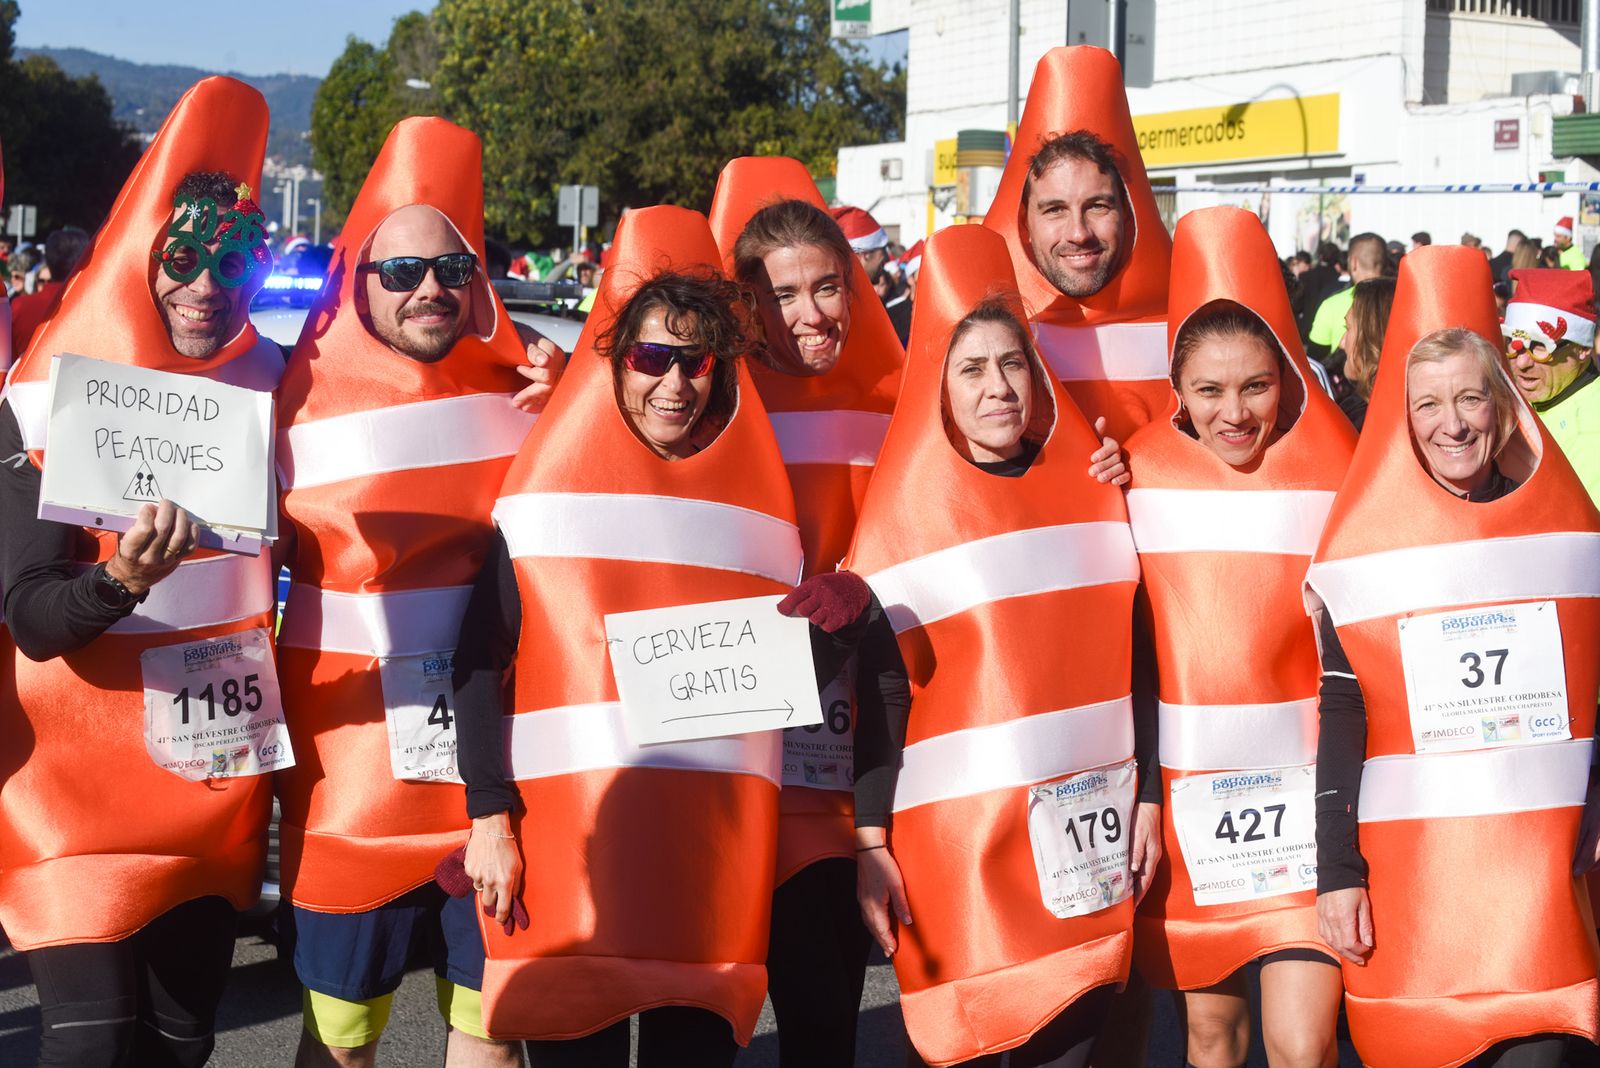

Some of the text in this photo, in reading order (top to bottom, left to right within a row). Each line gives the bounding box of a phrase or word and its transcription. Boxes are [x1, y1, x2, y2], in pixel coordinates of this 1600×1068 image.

[86, 379, 220, 422] PRIORIDAD
[95, 427, 224, 472] PEATONES
[1442, 616, 1516, 631] populares
[633, 619, 757, 665] CERVEZA
[1459, 648, 1509, 689] 37
[669, 664, 757, 701] GRATIS
[173, 673, 263, 724] 1185
[1438, 702, 1457, 710] SAN
[1458, 694, 1508, 707] SILVESTRE
[1509, 691, 1563, 702] CORDOBESA
[428, 693, 454, 731] 4
[1441, 710, 1466, 718] GLORIA
[172, 735, 190, 744] SAN
[191, 727, 239, 740] SILVESTRE
[240, 717, 281, 733] CORDOBESA
[1433, 726, 1475, 737] IMDECO
[1535, 717, 1556, 727] GCC
[261, 744, 278, 757] GCC
[418, 743, 435, 752] SAN
[1212, 777, 1282, 791] populares
[1065, 807, 1122, 853] 179
[1215, 804, 1286, 844] 427
[1064, 865, 1079, 875] SAN
[1080, 856, 1111, 870] SILVESTRE
[1208, 855, 1225, 864] SAN
[1227, 849, 1275, 860] SILVESTRE
[1063, 887, 1097, 903] IMDECO
